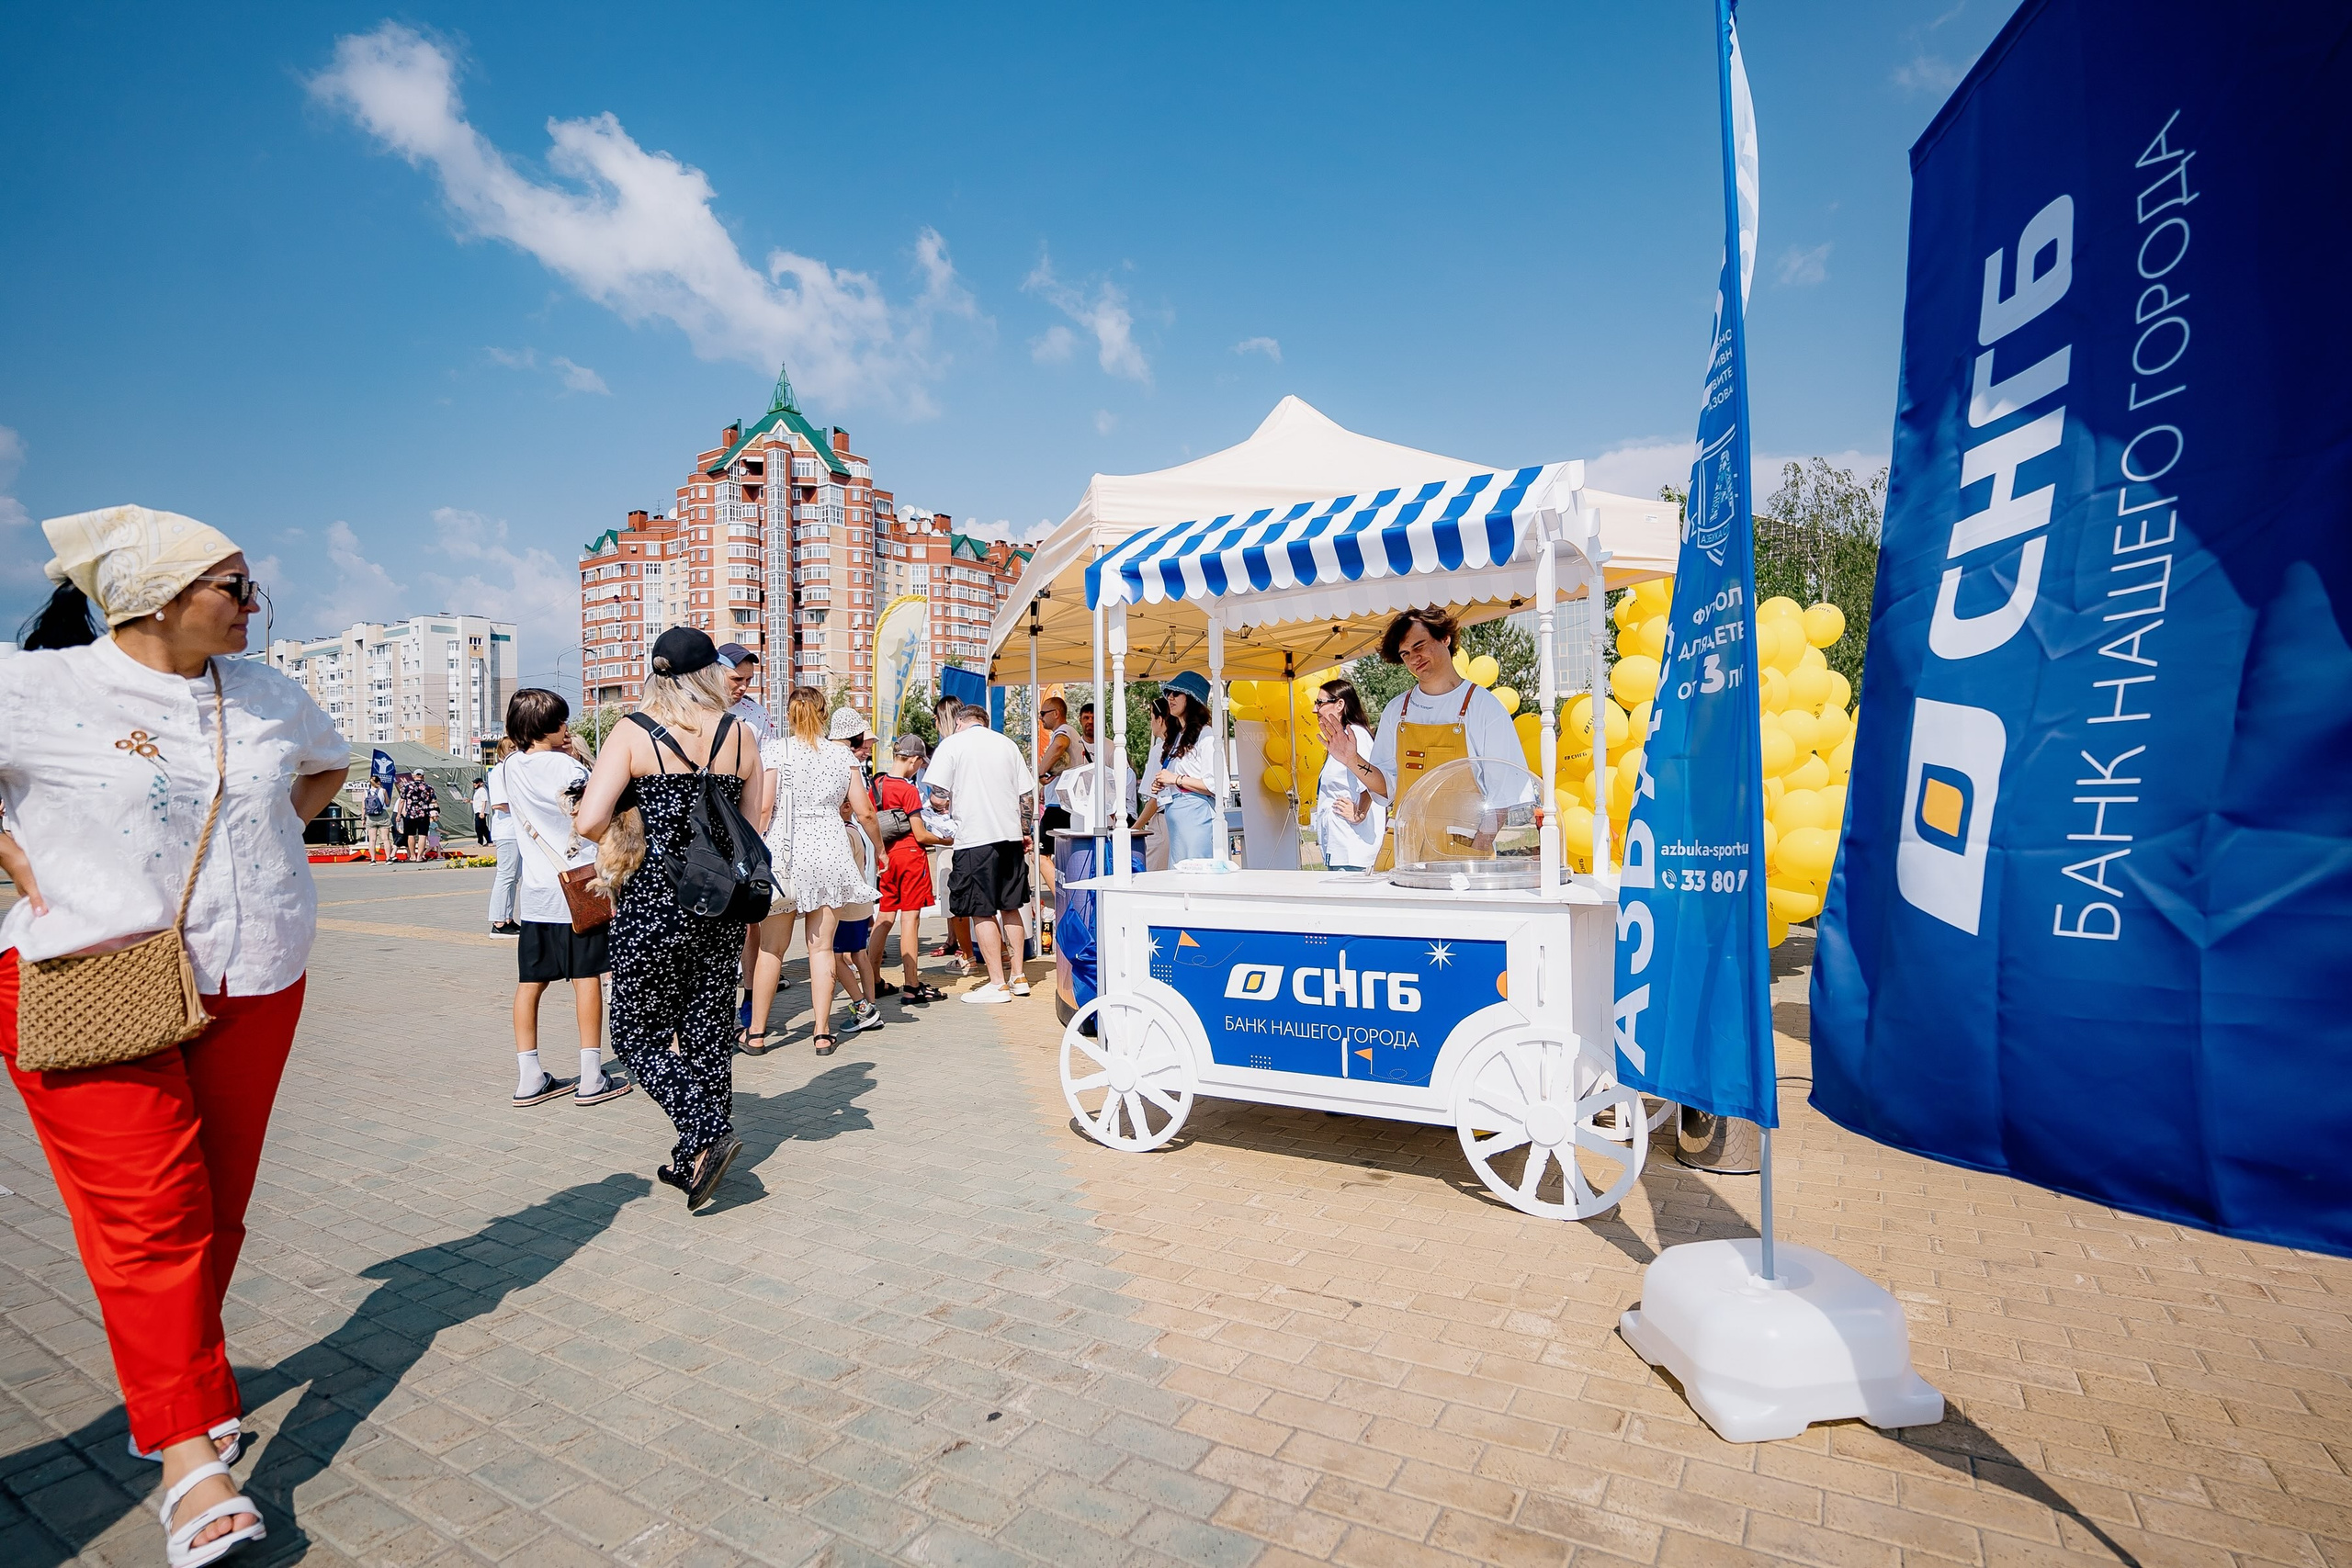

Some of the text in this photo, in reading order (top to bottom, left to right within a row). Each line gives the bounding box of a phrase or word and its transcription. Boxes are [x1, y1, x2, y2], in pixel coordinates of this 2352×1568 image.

[1928, 194, 2075, 660] СНГБ
[2052, 109, 2199, 942] БАНК НАШЕГО ГОРОДА
[1700, 653, 1725, 694] 3
[783, 761, 792, 791] LOVE
[1680, 869, 1706, 892] 33
[1292, 965, 1422, 1012] СНГБ
[1225, 1015, 1420, 1050] БАНК НАШЕГО ГОРОДА
